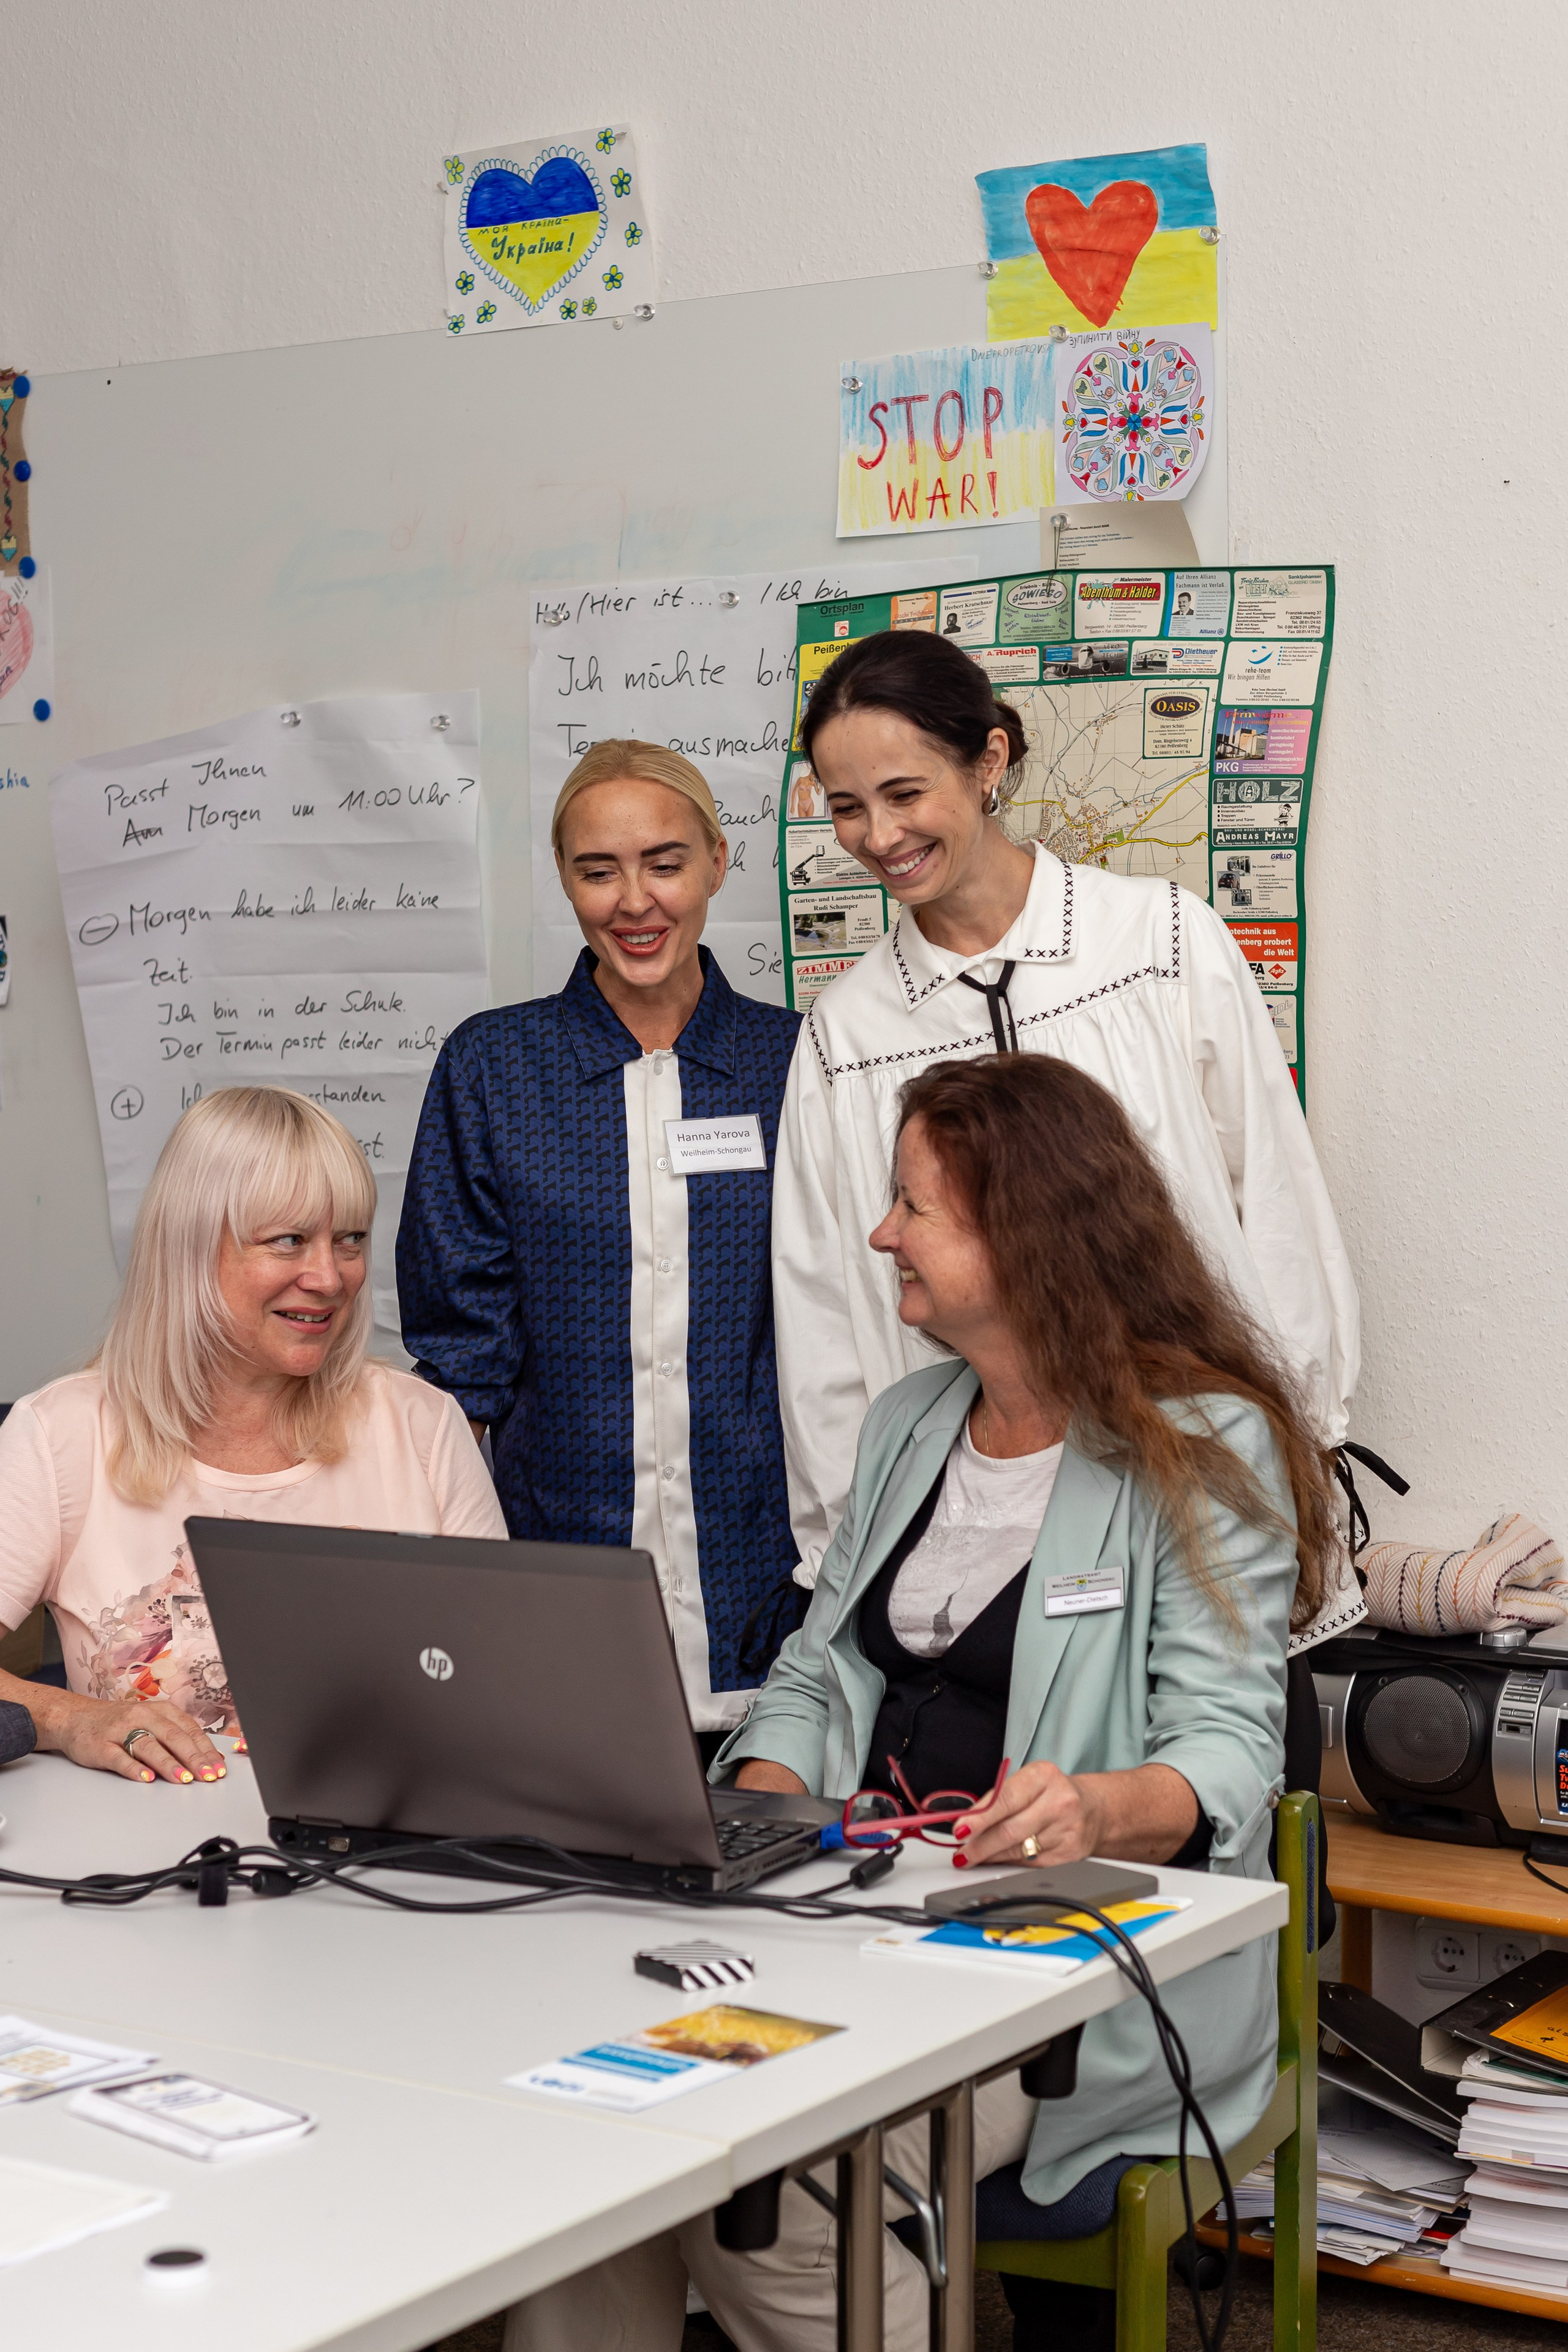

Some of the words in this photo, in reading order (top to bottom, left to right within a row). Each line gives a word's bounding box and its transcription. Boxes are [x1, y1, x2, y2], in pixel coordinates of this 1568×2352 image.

[858, 386, 1003, 470] STOP
[887, 471, 1000, 522] WAR!
[815, 579, 848, 599] bin
[1122, 587, 1128, 598] &
[1129, 586, 1157, 598] Halder
[820, 601, 864, 616] Ortsplan
[993, 648, 1036, 657] Ruprich
[557, 654, 604, 696] Ich
[625, 649, 726, 690] möchte
[1156, 700, 1196, 712] OASIS
[1216, 761, 1239, 772] PKG
[104, 778, 170, 815] Passt
[1216, 781, 1300, 802] HOLZ
[187, 804, 261, 832] Morgen
[292, 803, 314, 818] um
[1216, 832, 1259, 842] ANDREAS
[1265, 831, 1294, 841] MAYR
[129, 902, 212, 936] Morgen
[231, 888, 275, 919] habe
[290, 886, 315, 916] ich
[331, 886, 377, 913] leider
[748, 943, 782, 975] Sie
[157, 1003, 196, 1025] Ich
[213, 996, 238, 1020] bin
[258, 998, 275, 1018] in
[294, 997, 328, 1015] der
[160, 1038, 202, 1061] Der
[281, 1033, 326, 1060] passt
[338, 1027, 383, 1051] leider
[677, 1133, 711, 1142] Hanna
[714, 1130, 750, 1139] Yarova
[680, 1147, 752, 1157] Weilheim-Schongau
[424, 1647, 450, 1681] hp
